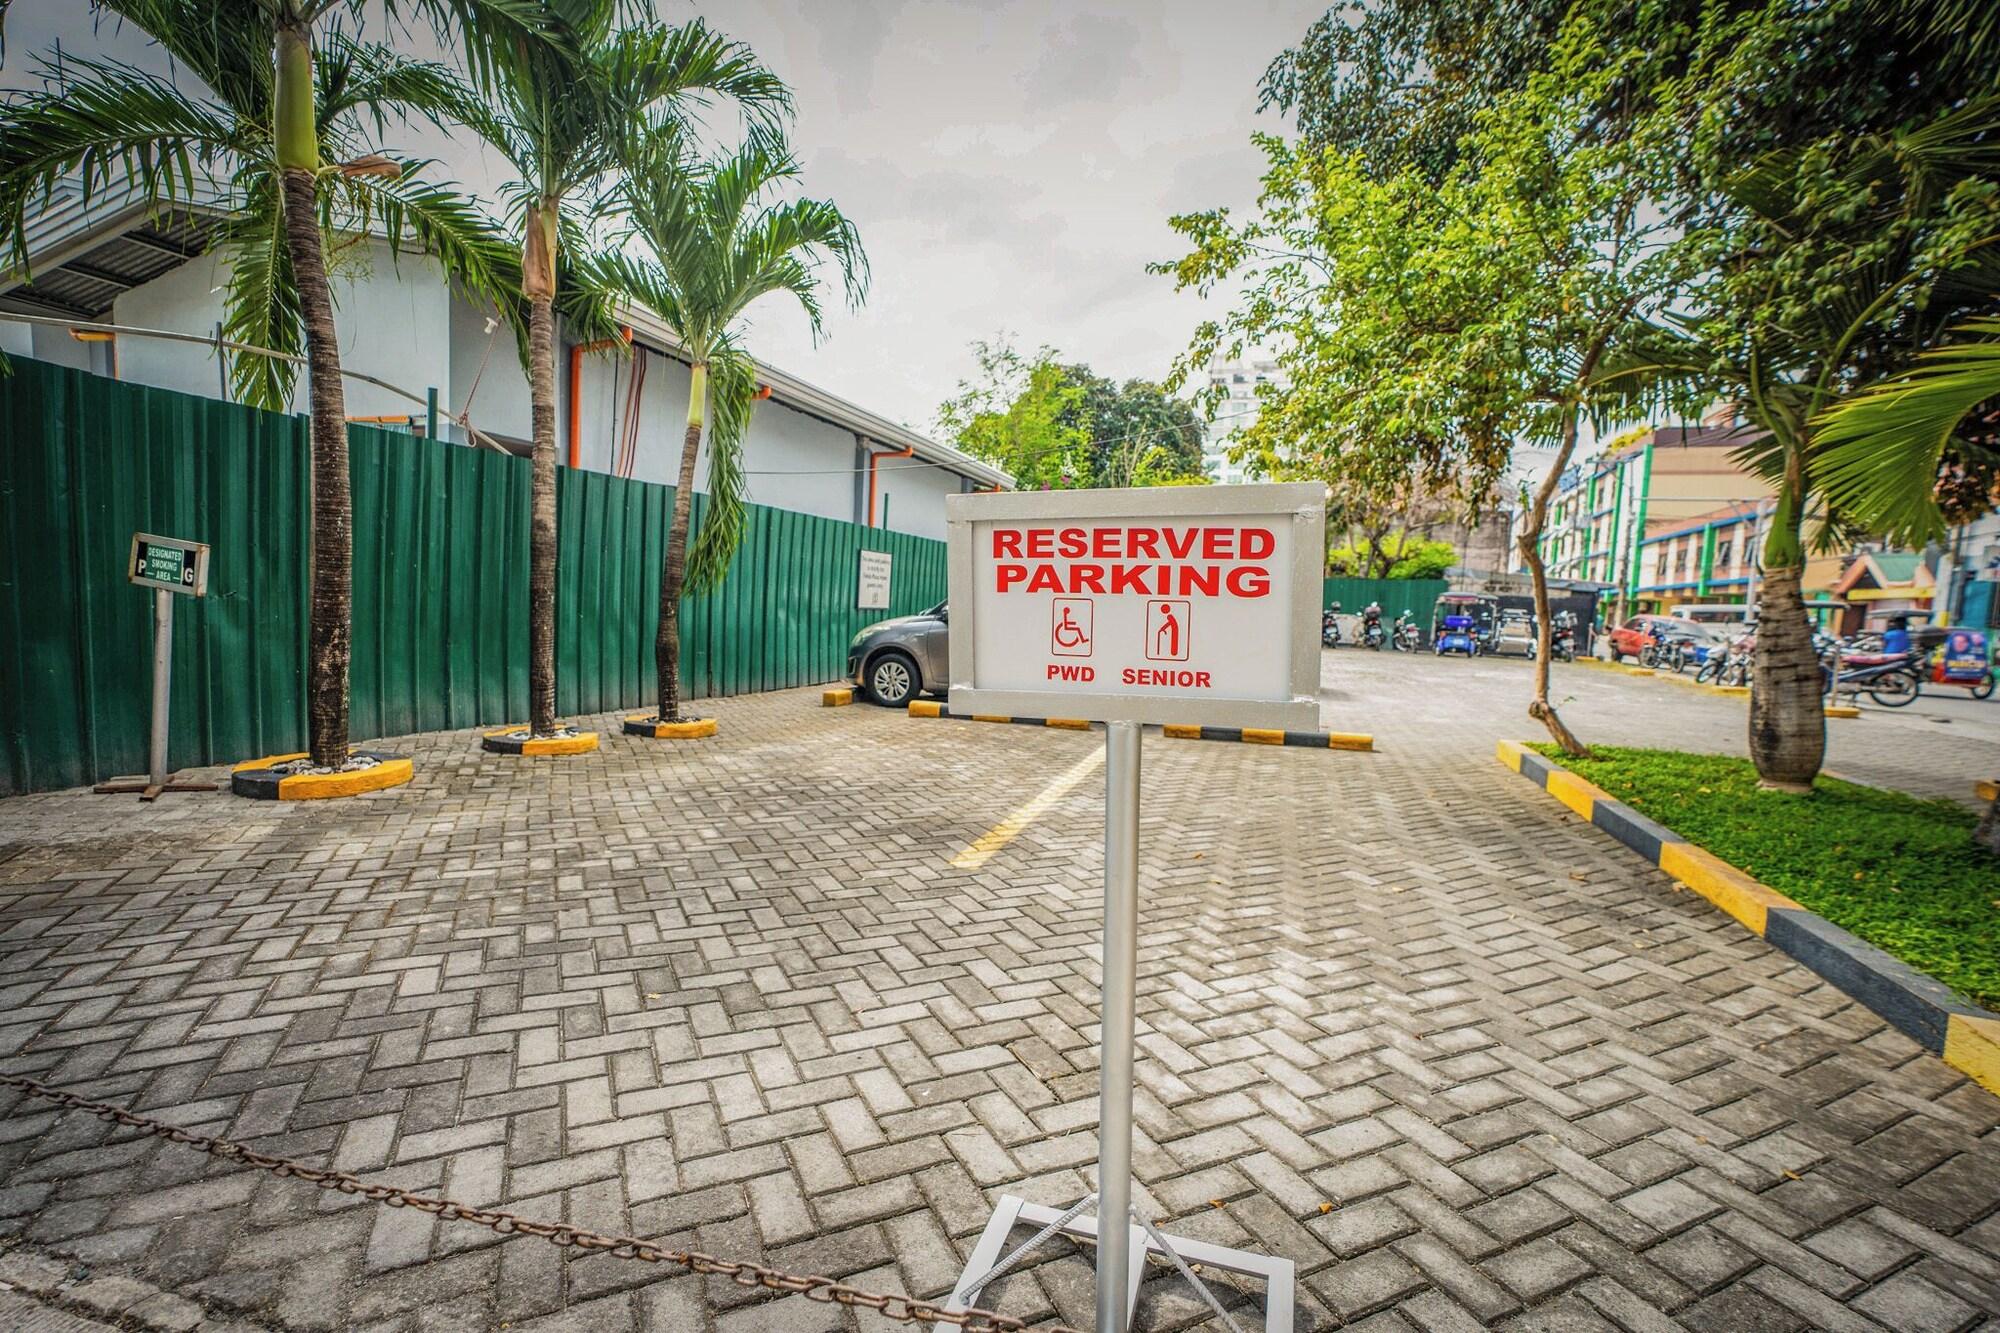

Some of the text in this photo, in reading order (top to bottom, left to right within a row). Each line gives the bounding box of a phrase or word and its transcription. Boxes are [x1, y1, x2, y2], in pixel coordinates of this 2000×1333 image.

[993, 527, 1276, 560] RESERVED
[148, 547, 182, 562] DESIGNATED
[151, 559, 178, 571] SMOKING
[156, 570, 171, 582] AREA
[996, 564, 1271, 598] PARKING
[1047, 664, 1212, 689] PWD SENIOR
